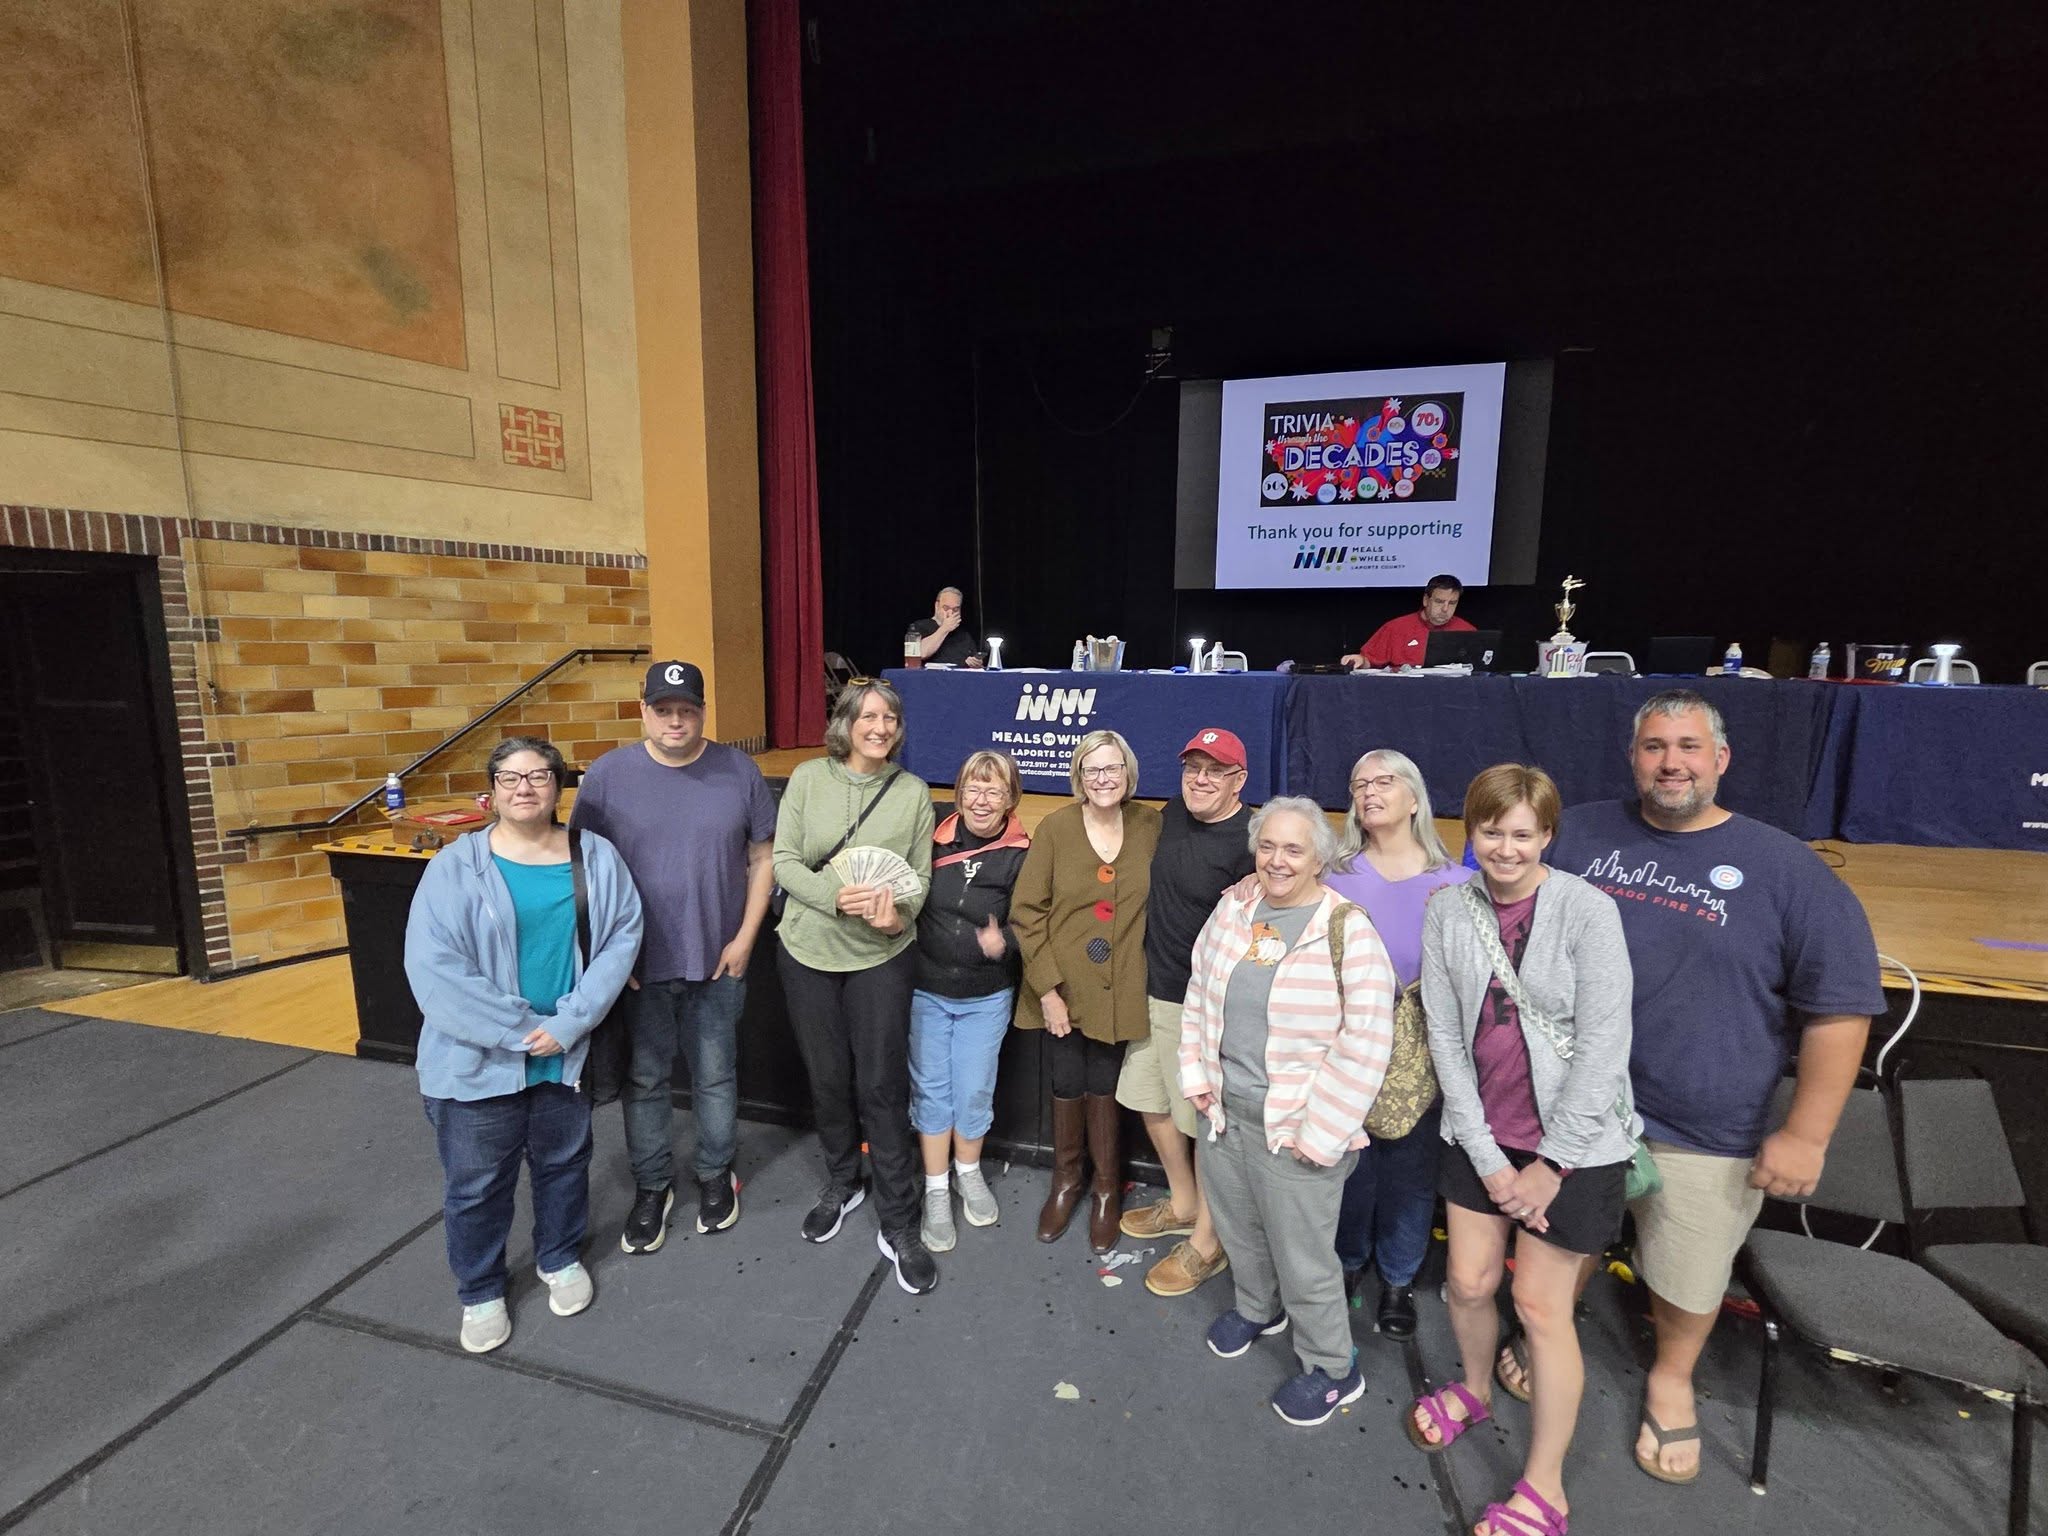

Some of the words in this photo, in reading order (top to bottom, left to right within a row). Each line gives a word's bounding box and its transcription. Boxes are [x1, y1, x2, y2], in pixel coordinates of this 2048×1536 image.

[1270, 413, 1334, 434] TRIVIA
[1416, 413, 1439, 427] 70s
[1277, 434, 1312, 445] through
[1313, 433, 1329, 443] the
[1285, 441, 1419, 470] DECADES
[1248, 524, 1297, 539] Thank
[1303, 528, 1333, 541] you
[1339, 523, 1363, 537] for
[1367, 520, 1463, 540] supporting
[992, 732, 1040, 744] MEALS
[1011, 749, 1056, 757] LAPORTE
[1595, 883, 1647, 901] ICAGO
[1652, 896, 1690, 912] FIRE
[1696, 908, 1718, 922] FC
